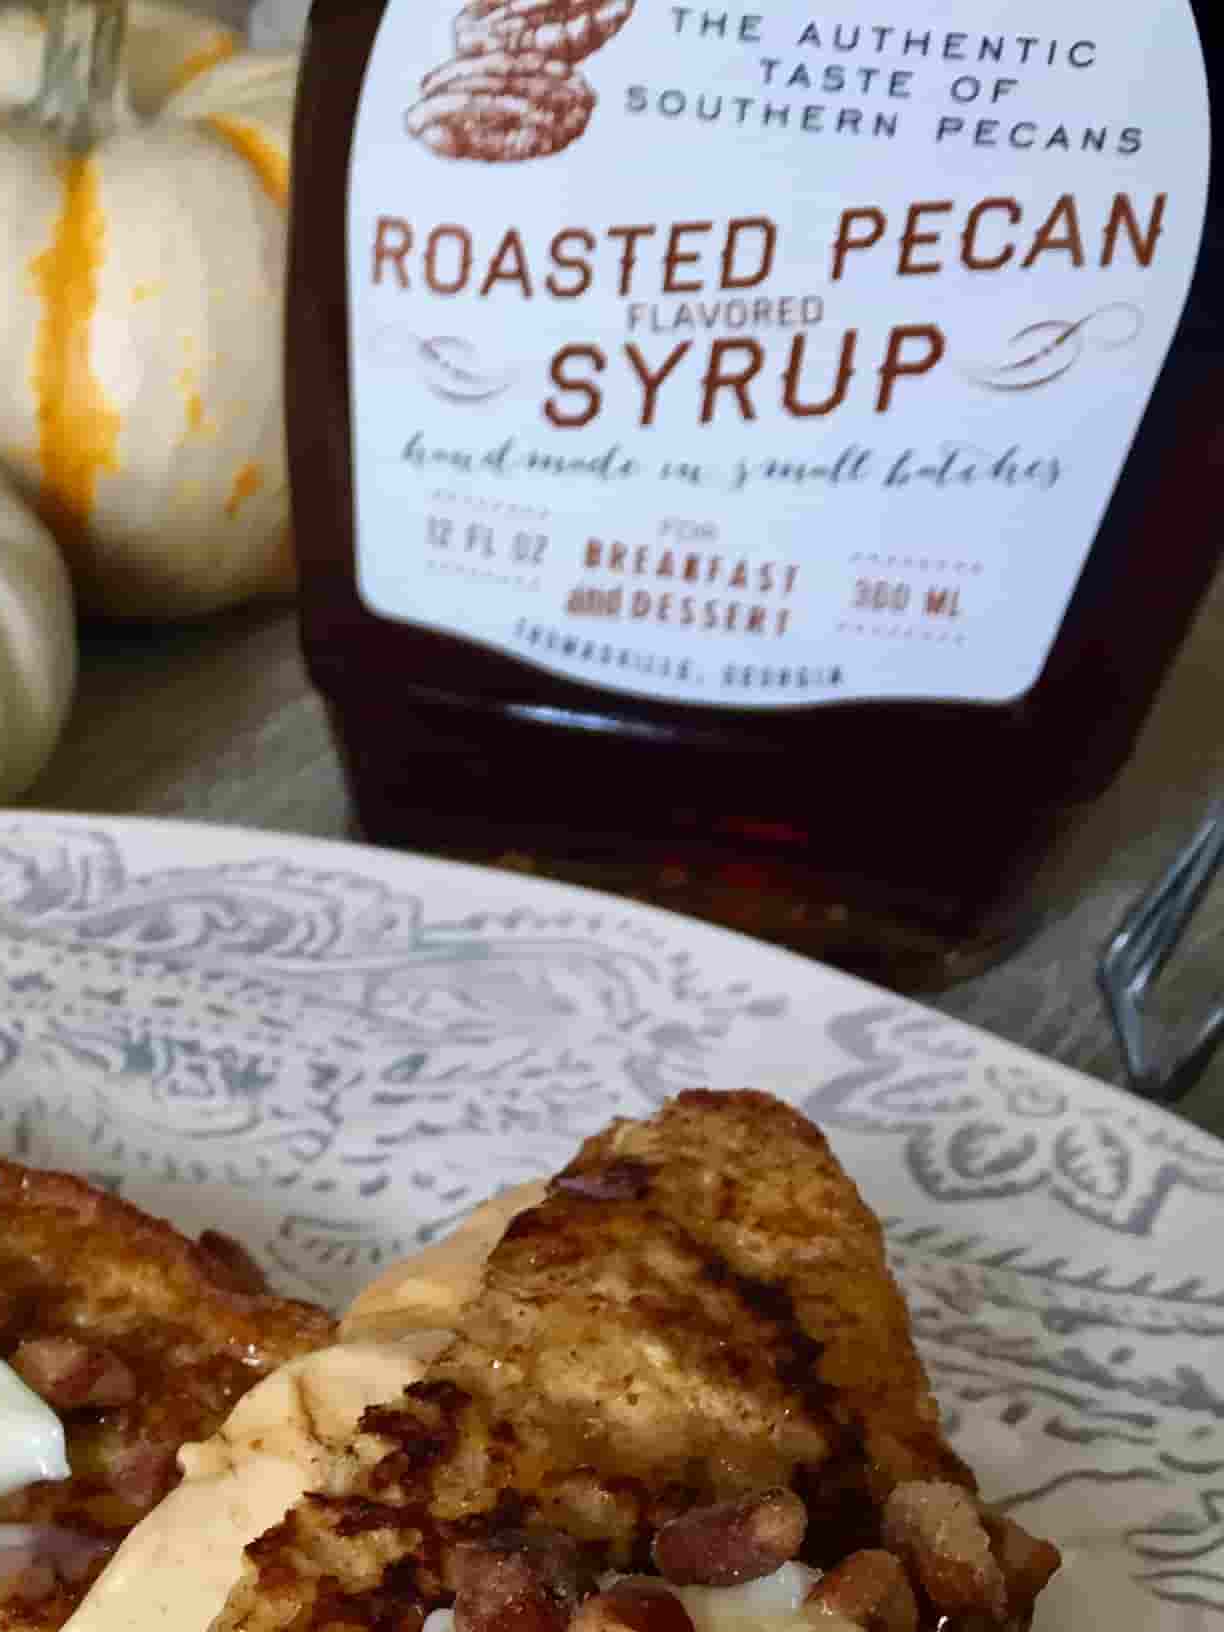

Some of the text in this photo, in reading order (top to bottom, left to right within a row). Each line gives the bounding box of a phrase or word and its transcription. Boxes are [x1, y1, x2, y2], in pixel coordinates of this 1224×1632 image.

[671, 6, 1098, 69] THE AUTHENTIC
[760, 57, 1019, 103] TASTE OF
[623, 84, 1144, 156] SOUTHERN PECANS
[370, 193, 1168, 299] ROASTED PECAN
[626, 296, 824, 333] FLAVORED
[542, 322, 946, 430] SYRUP
[584, 538, 801, 594] BREAKFAST
[630, 588, 793, 638] DESSERT
